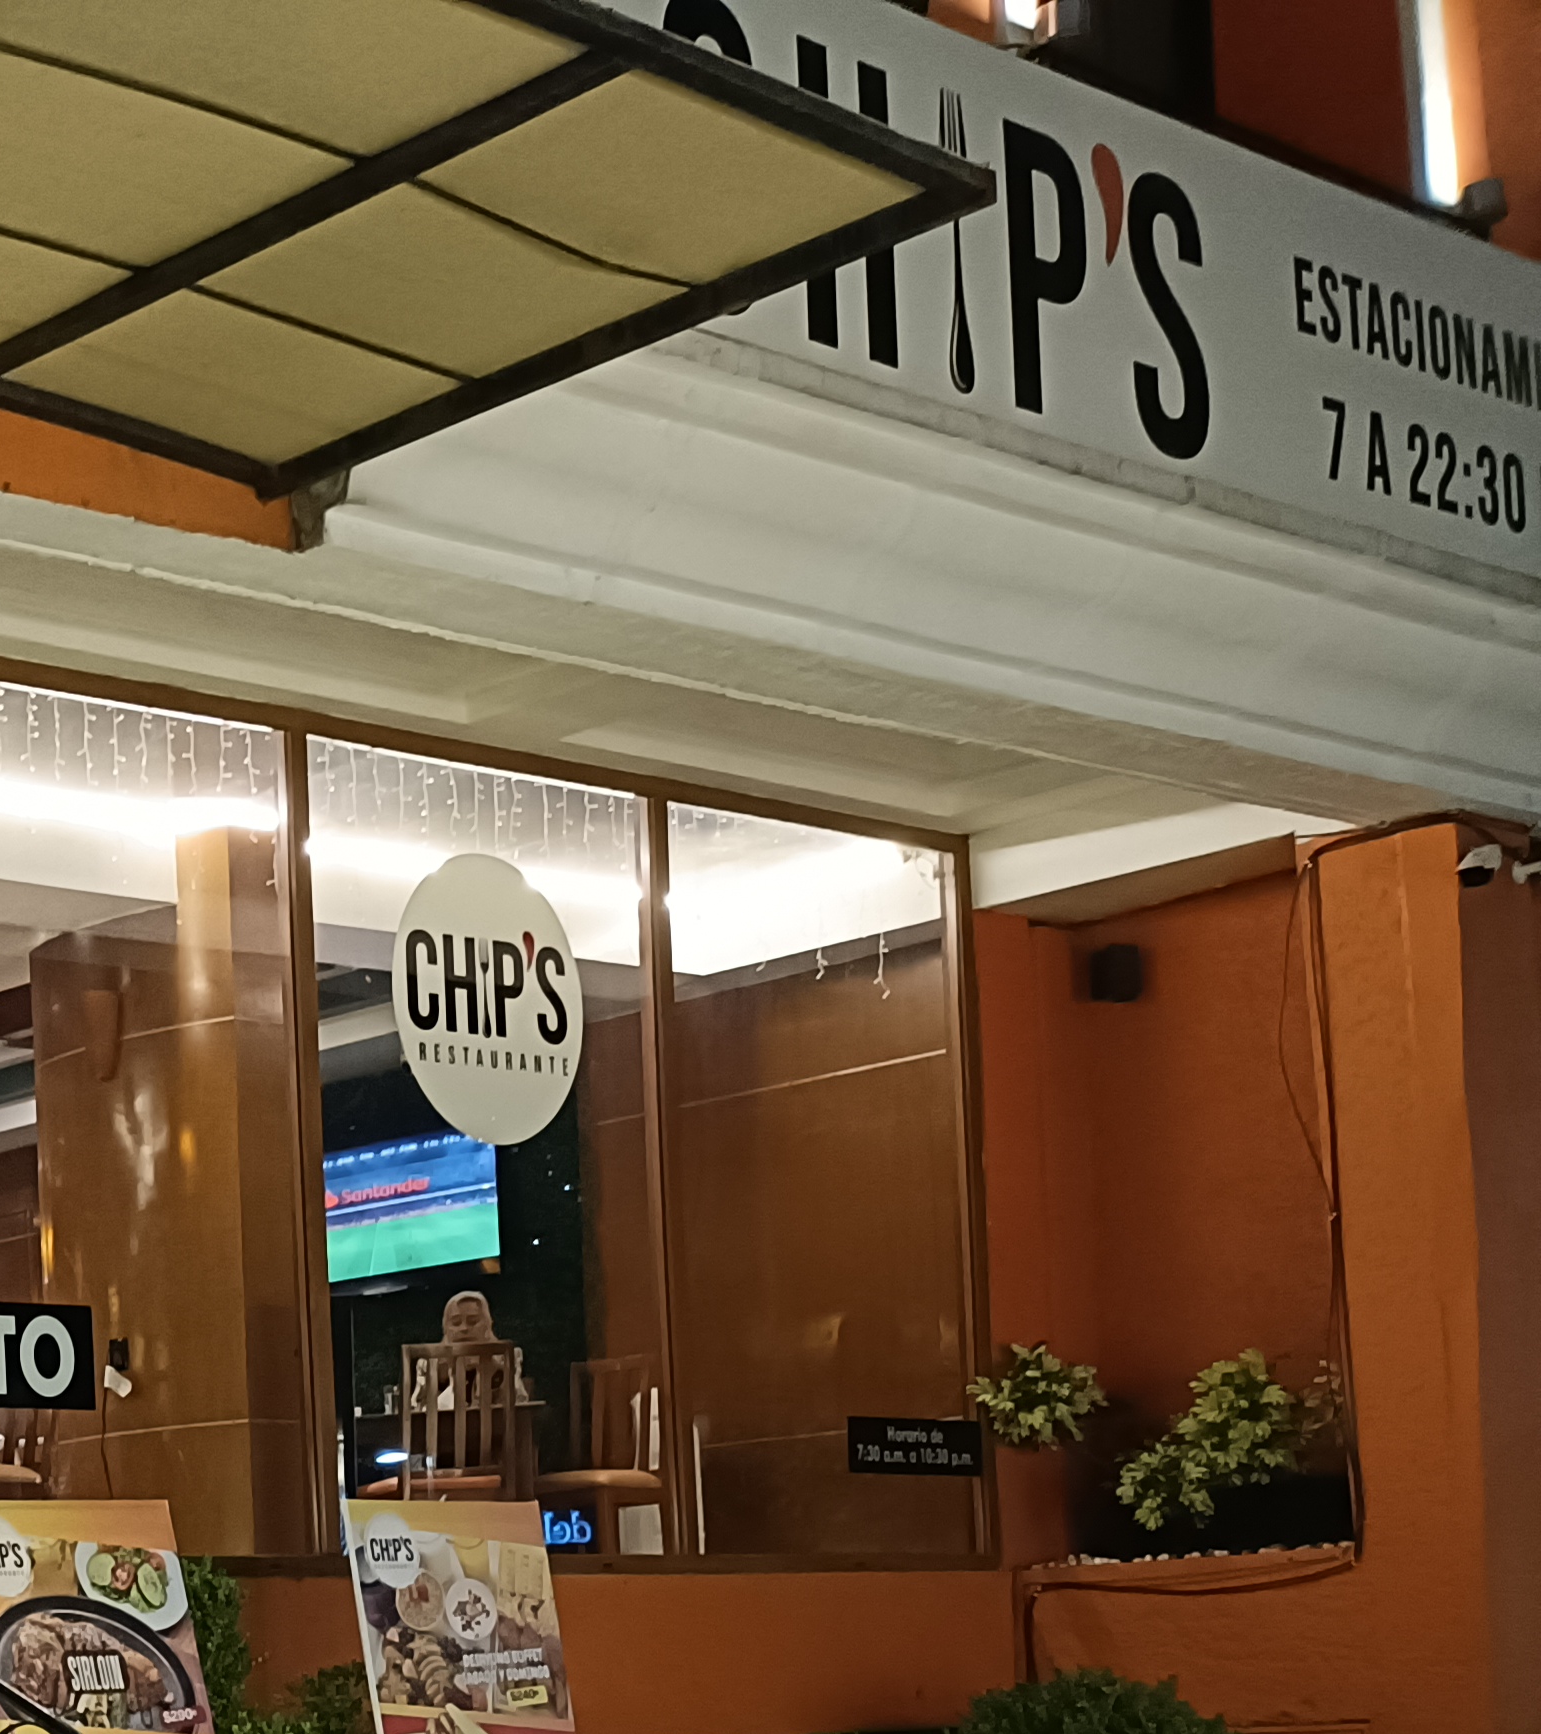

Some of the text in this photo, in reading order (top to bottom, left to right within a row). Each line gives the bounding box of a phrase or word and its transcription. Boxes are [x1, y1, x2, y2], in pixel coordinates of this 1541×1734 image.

[1322, 396, 1527, 534] 7 A 22:30
[406, 929, 567, 1045] CHIP'S
[419, 1042, 569, 1077] RESTAURANTE
[857, 1443, 881, 1462] 7:30
[930, 1428, 944, 1444] de
[369, 1534, 415, 1562] CHIP'S
[67, 1654, 125, 1692] SIRLOIN
